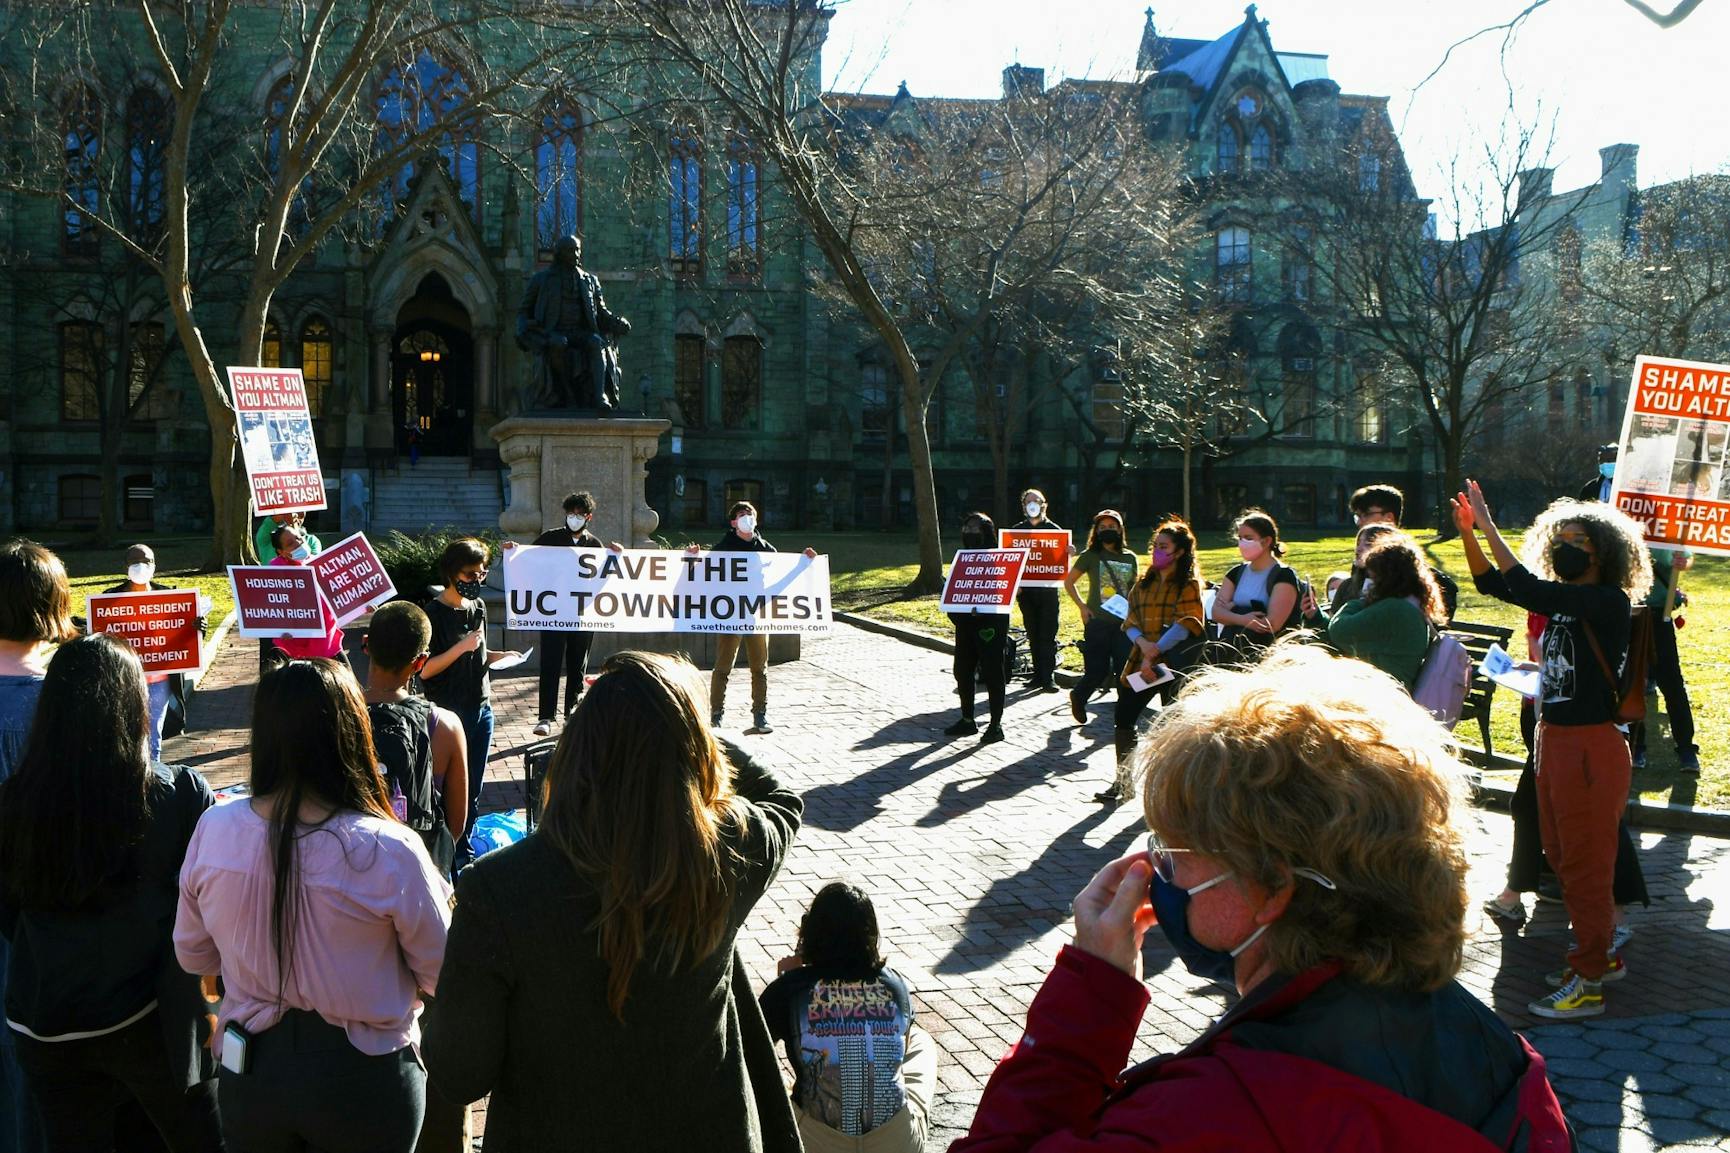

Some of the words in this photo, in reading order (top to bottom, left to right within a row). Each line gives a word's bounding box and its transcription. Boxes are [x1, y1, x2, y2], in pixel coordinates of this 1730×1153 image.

[235, 376, 280, 391] SHAME
[284, 377, 300, 391] ON
[1644, 367, 1730, 396] SHAME
[238, 392, 260, 407] YOU
[263, 393, 303, 407] ALTMAN
[1641, 389, 1683, 412] YOU
[1686, 395, 1730, 417] ALT
[254, 476, 281, 490] DON'T
[282, 475, 306, 487] TREAT
[307, 474, 319, 486] US
[257, 489, 285, 507] LIKE
[285, 486, 321, 504] TRASH
[1620, 497, 1671, 516] DON'T
[1675, 502, 1729, 523] TREAT
[1634, 515, 1669, 538] KE
[1012, 539, 1037, 548] SAVE
[1039, 539, 1059, 548] THE
[318, 546, 366, 578] ALTMAN,
[961, 553, 975, 562] WE
[976, 553, 1001, 562] FIGHT
[1002, 553, 1021, 562] FOR
[1029, 552, 1042, 560] UC
[578, 553, 667, 581] SAVE
[681, 557, 748, 582] THE
[965, 566, 984, 576] OUR
[984, 566, 1007, 576] KIDS
[1025, 565, 1065, 574] NHOMES
[245, 578, 293, 589] HOUSING
[295, 578, 305, 589] IS
[328, 573, 352, 593] ARE
[348, 560, 373, 580] YOU
[332, 573, 384, 610] HUMAN??
[954, 580, 974, 589] OUR
[974, 580, 1008, 589] ELDERS
[267, 593, 290, 604] OUR
[510, 589, 558, 616] UC
[570, 591, 823, 620] TOWNHOMES!
[952, 594, 971, 603] OUR
[971, 594, 1003, 603] HOMES
[96, 606, 137, 618] RAGED,
[139, 602, 192, 615] RESIDENT
[245, 608, 286, 619] HUMAN
[287, 608, 317, 619] RIGHT
[106, 621, 146, 633] ACTION
[148, 618, 185, 631] GROUP
[508, 618, 615, 629] @saveuctownhomes
[690, 623, 829, 632] savetheuctownhomes.com
[127, 637, 141, 648] TO
[143, 636, 166, 647] END
[138, 650, 189, 663] ACEMENT
